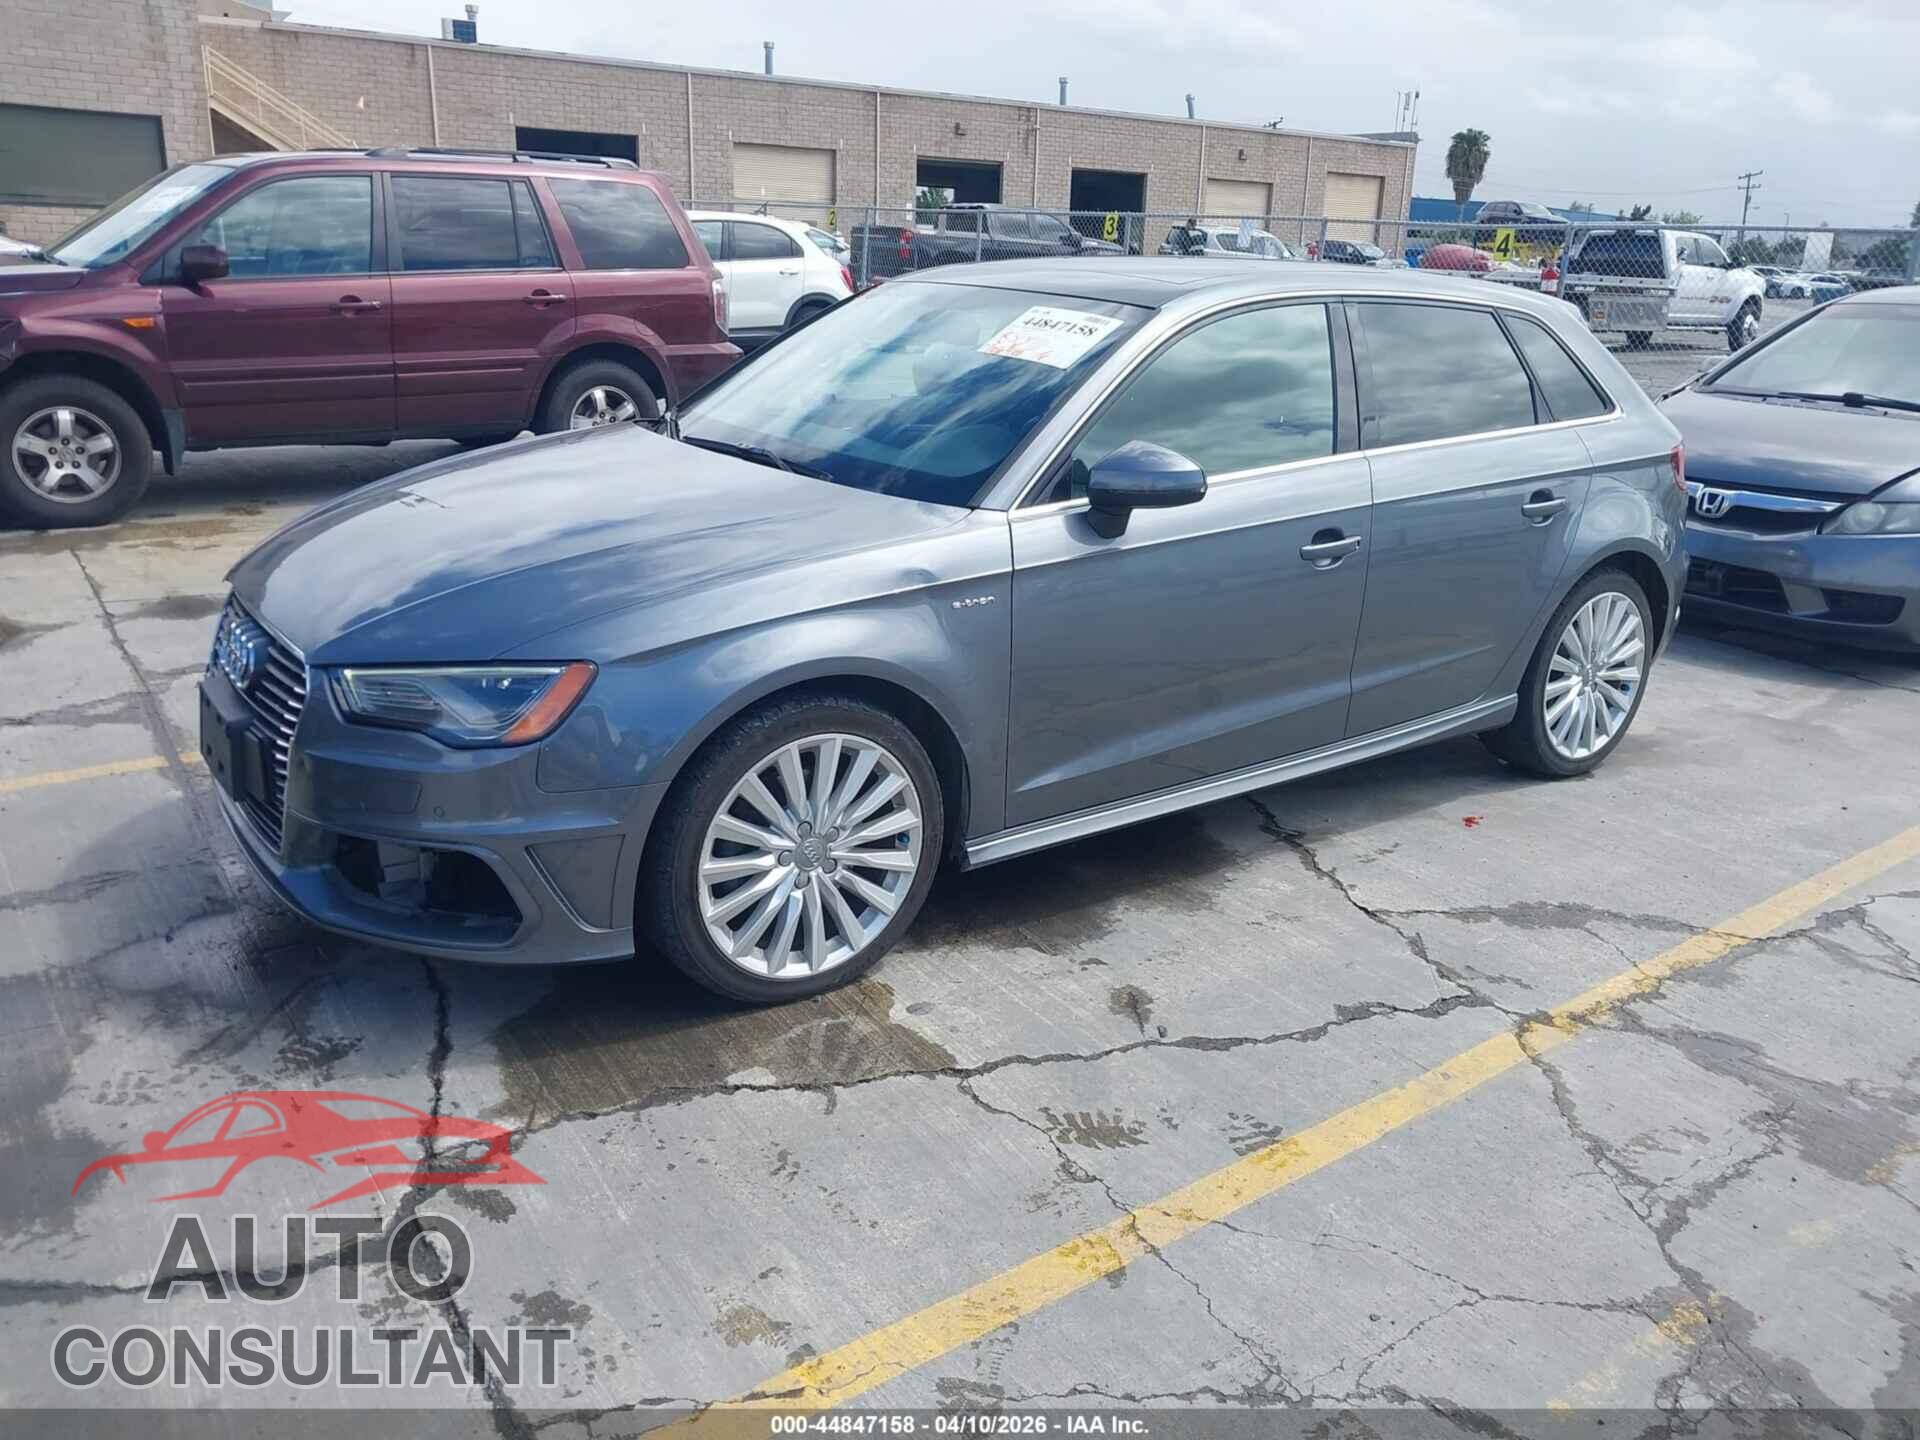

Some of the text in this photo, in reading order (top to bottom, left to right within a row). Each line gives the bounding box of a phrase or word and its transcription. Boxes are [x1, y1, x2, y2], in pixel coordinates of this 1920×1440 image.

[1106, 216, 1116, 236] 3
[1495, 232, 1511, 258] 4
[1023, 316, 1098, 337] 44847158
